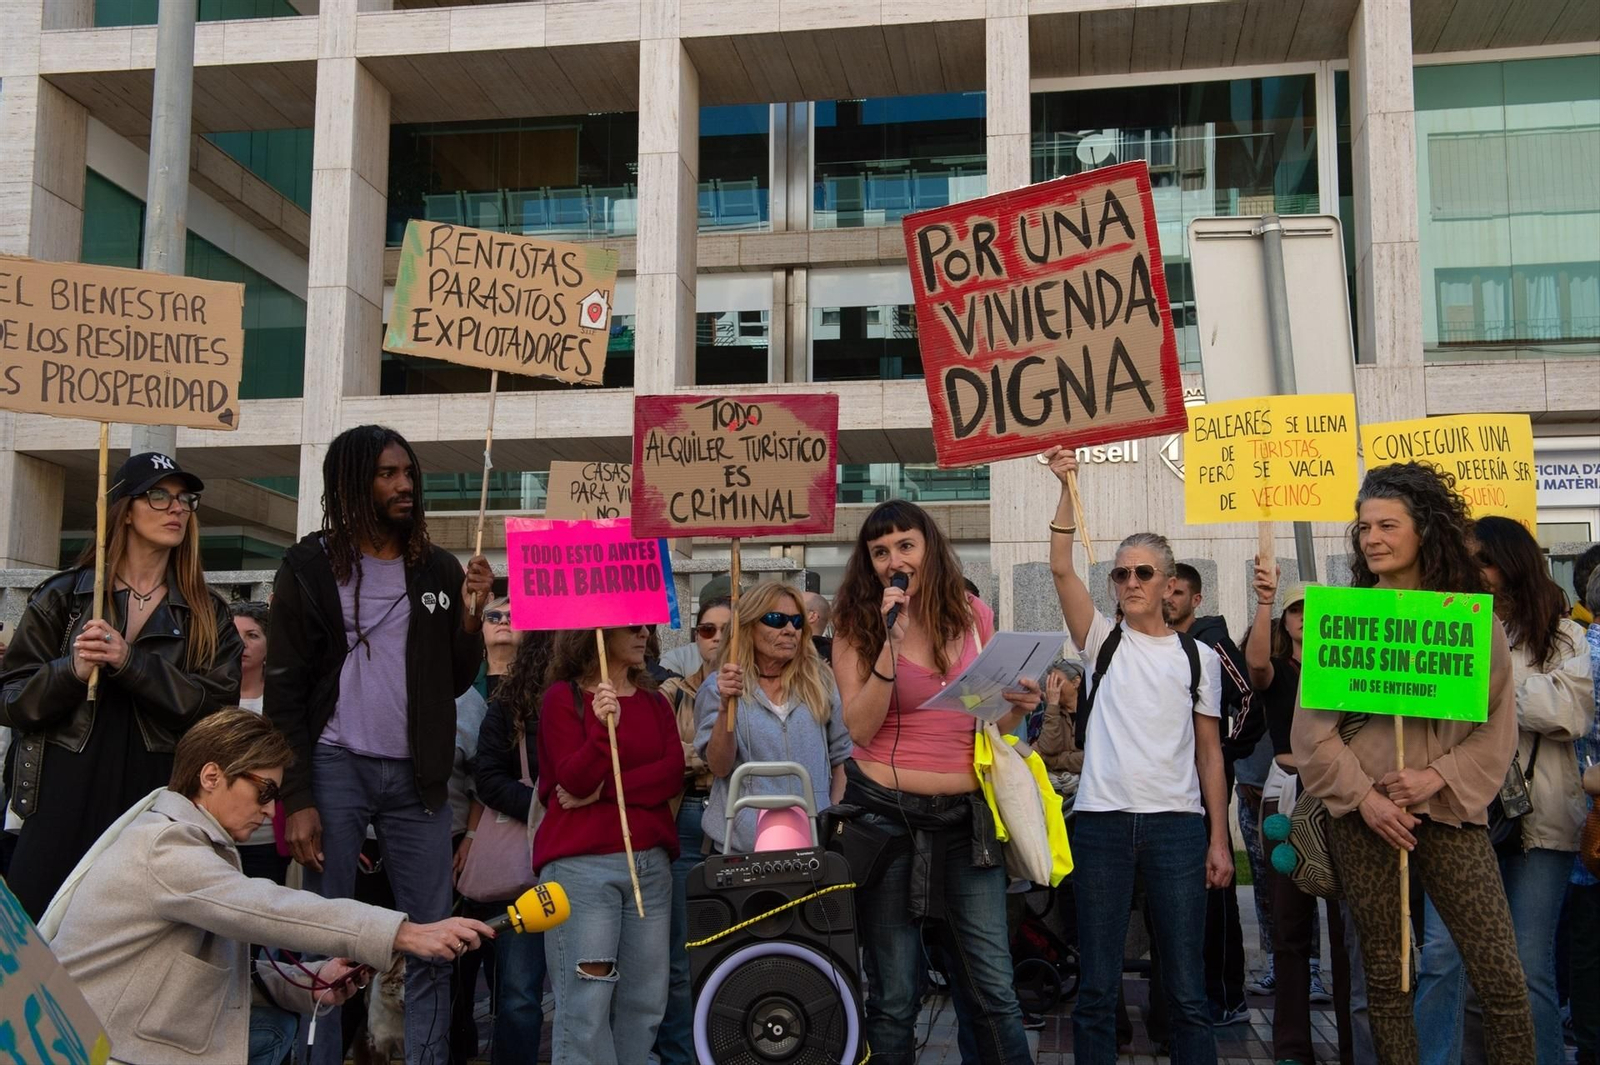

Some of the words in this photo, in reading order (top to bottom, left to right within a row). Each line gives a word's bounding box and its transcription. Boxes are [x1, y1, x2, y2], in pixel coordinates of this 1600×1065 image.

[1020, 188, 1136, 264] UNA
[51, 279, 207, 324] BIENESTAR
[429, 268, 567, 327] PARASITOS
[938, 252, 1160, 356] VIVIENDA
[0, 319, 19, 350] E
[27, 322, 69, 353] LOS
[412, 308, 592, 376] EXPLOTADORES
[944, 337, 1156, 439] DIGNA
[695, 398, 762, 432] TODO
[1194, 410, 1272, 442] BALEARES
[1285, 416, 1298, 433] SE
[1306, 415, 1347, 433] LLENA
[1222, 446, 1235, 462] DE
[1372, 426, 1474, 460] CONSEGUIR
[1478, 426, 1511, 453] UNA
[582, 462, 631, 484] CASAS
[724, 465, 751, 488] ES
[1199, 463, 1234, 484] PERO
[1253, 460, 1270, 478] SE
[1457, 457, 1509, 481] DEBERÍA
[1513, 460, 1532, 481] SER
[1544, 475, 1600, 490] MATÈRI
[571, 481, 610, 504] PARA
[1220, 492, 1237, 511] DE
[1252, 483, 1321, 508] VECINOS
[597, 505, 620, 519] NO
[521, 544, 563, 566] TODO
[566, 543, 603, 565] ESTO
[608, 541, 656, 563] ANTES
[523, 567, 568, 597] ERA
[573, 562, 661, 596] BARRIO
[1319, 614, 1379, 642] GENTE
[1383, 617, 1417, 644] SIN
[1421, 619, 1474, 648] CASA
[1318, 644, 1376, 671] CASAS
[1379, 647, 1410, 674] SIN
[1415, 649, 1474, 677] GENTE
[1349, 678, 1367, 693] ¡NO
[1369, 679, 1381, 694] SE
[1383, 680, 1437, 698] ENTIENDE!
